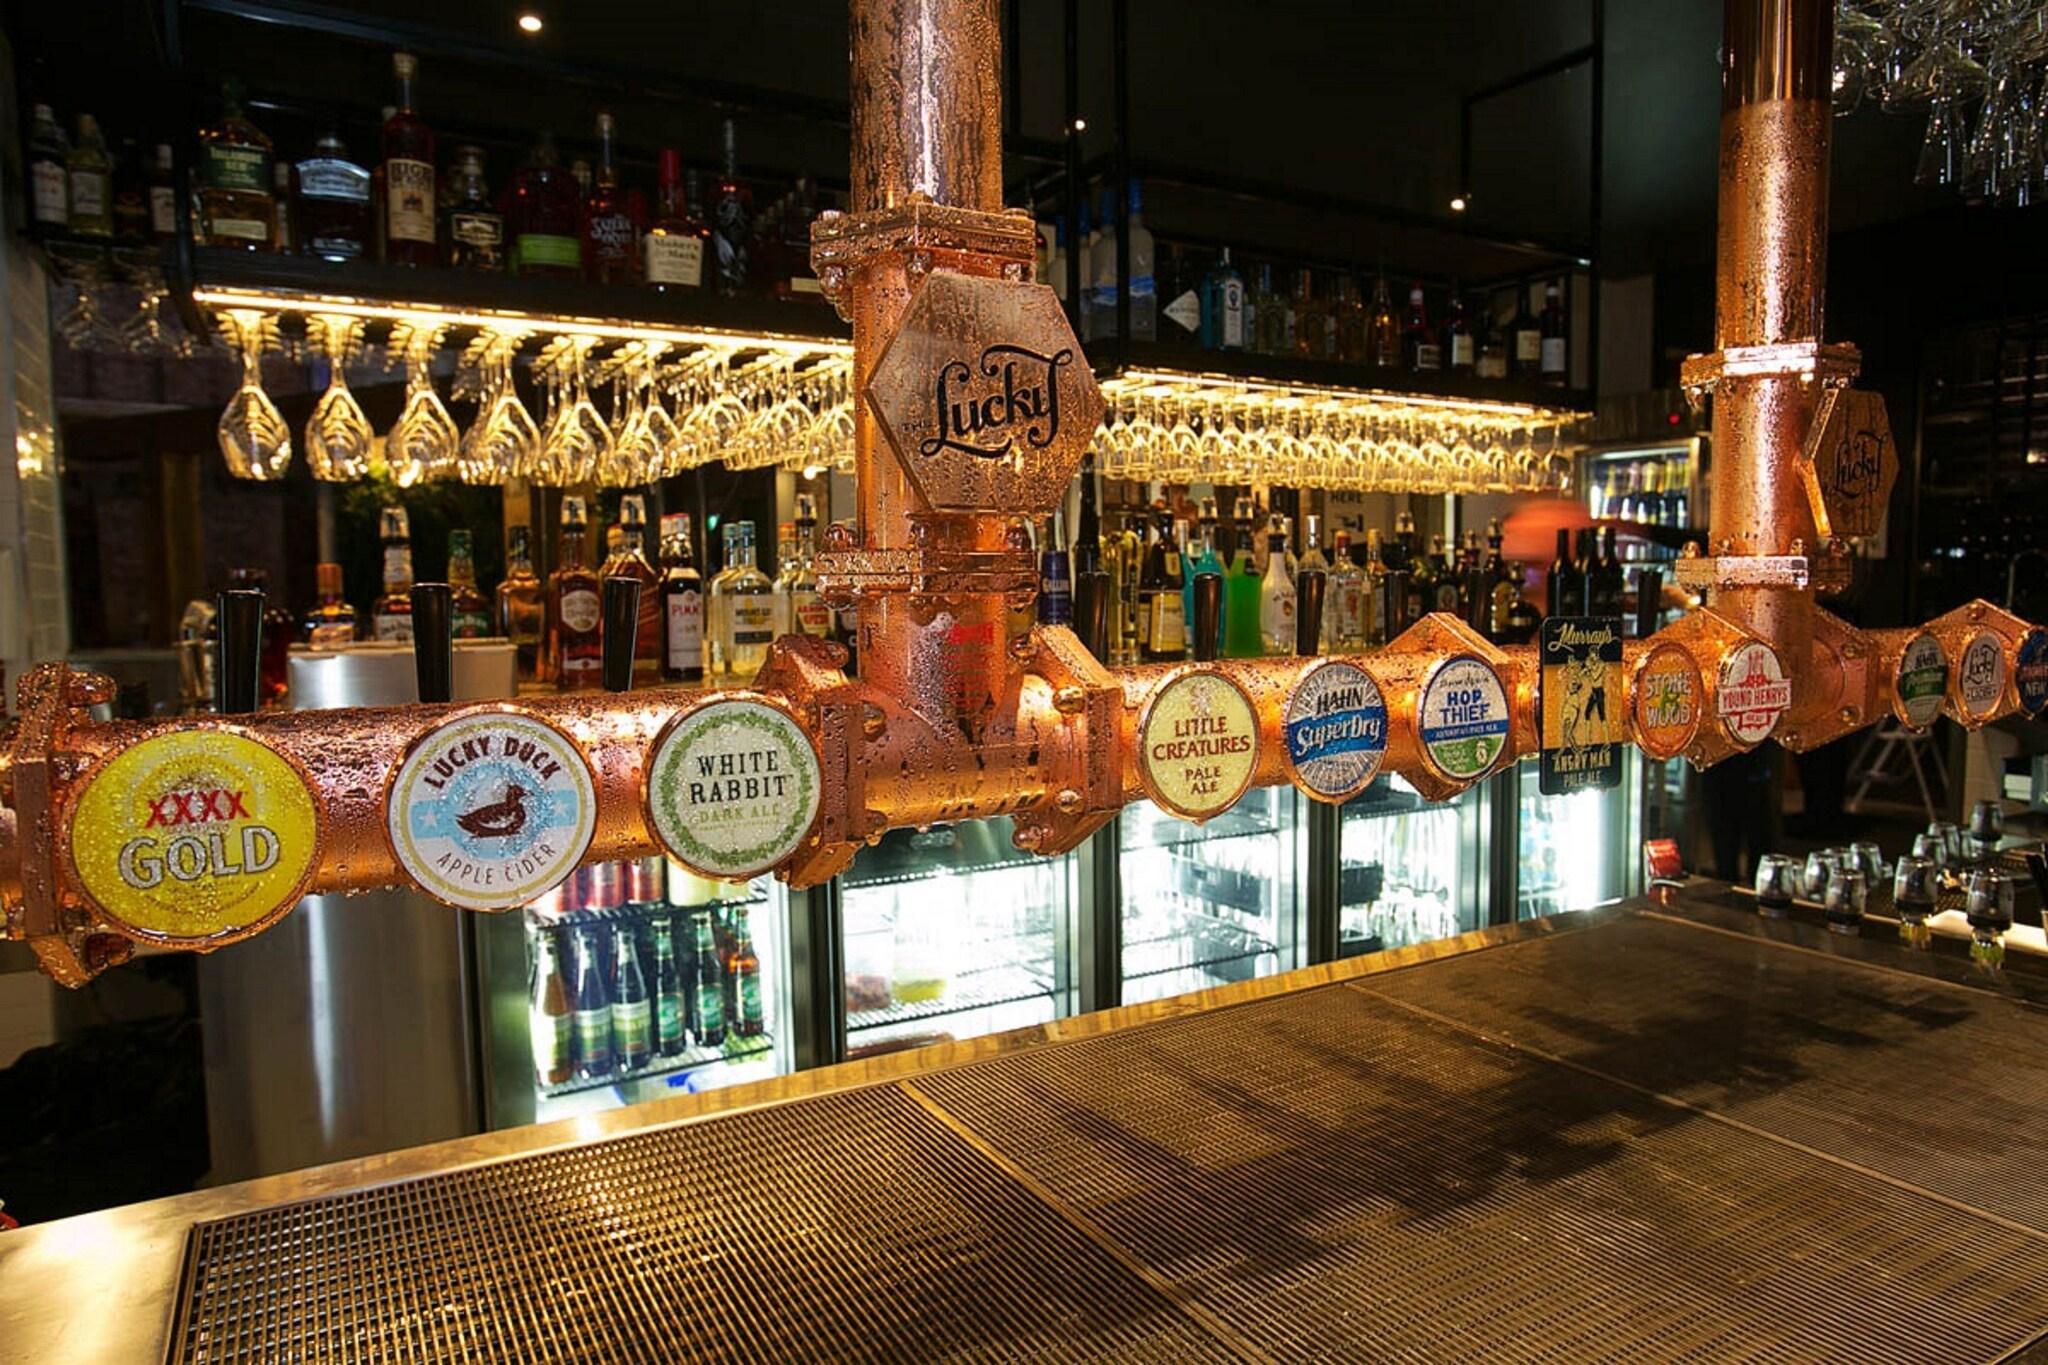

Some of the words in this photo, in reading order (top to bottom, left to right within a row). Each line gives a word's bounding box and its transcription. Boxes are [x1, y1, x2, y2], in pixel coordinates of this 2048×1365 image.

[920, 344, 1073, 459] Lucky
[1547, 621, 1621, 652] Murray's
[1446, 689, 1482, 706] HOP
[1645, 672, 1692, 697] STONE
[1316, 687, 1364, 716] HAHN
[1723, 689, 1752, 709] YOUNG
[1174, 716, 1228, 737] LITTLE
[1439, 703, 1490, 725] THIEF
[1646, 705, 1691, 728] WOOD
[1152, 734, 1251, 761] CREATURES
[423, 735, 490, 790] LUCKY
[503, 736, 561, 780] DUCK
[697, 750, 779, 777] WHITE
[1185, 766, 1221, 781] PALE
[1552, 752, 1588, 773] ANGRY
[690, 775, 786, 805] RABBIT
[1190, 781, 1219, 795] ALE
[145, 790, 251, 828] XXXX
[698, 807, 744, 823] DARK
[751, 802, 780, 818] ALE
[118, 825, 281, 889] GOLD
[436, 852, 493, 885] APPLE
[505, 843, 556, 882] CIDER
